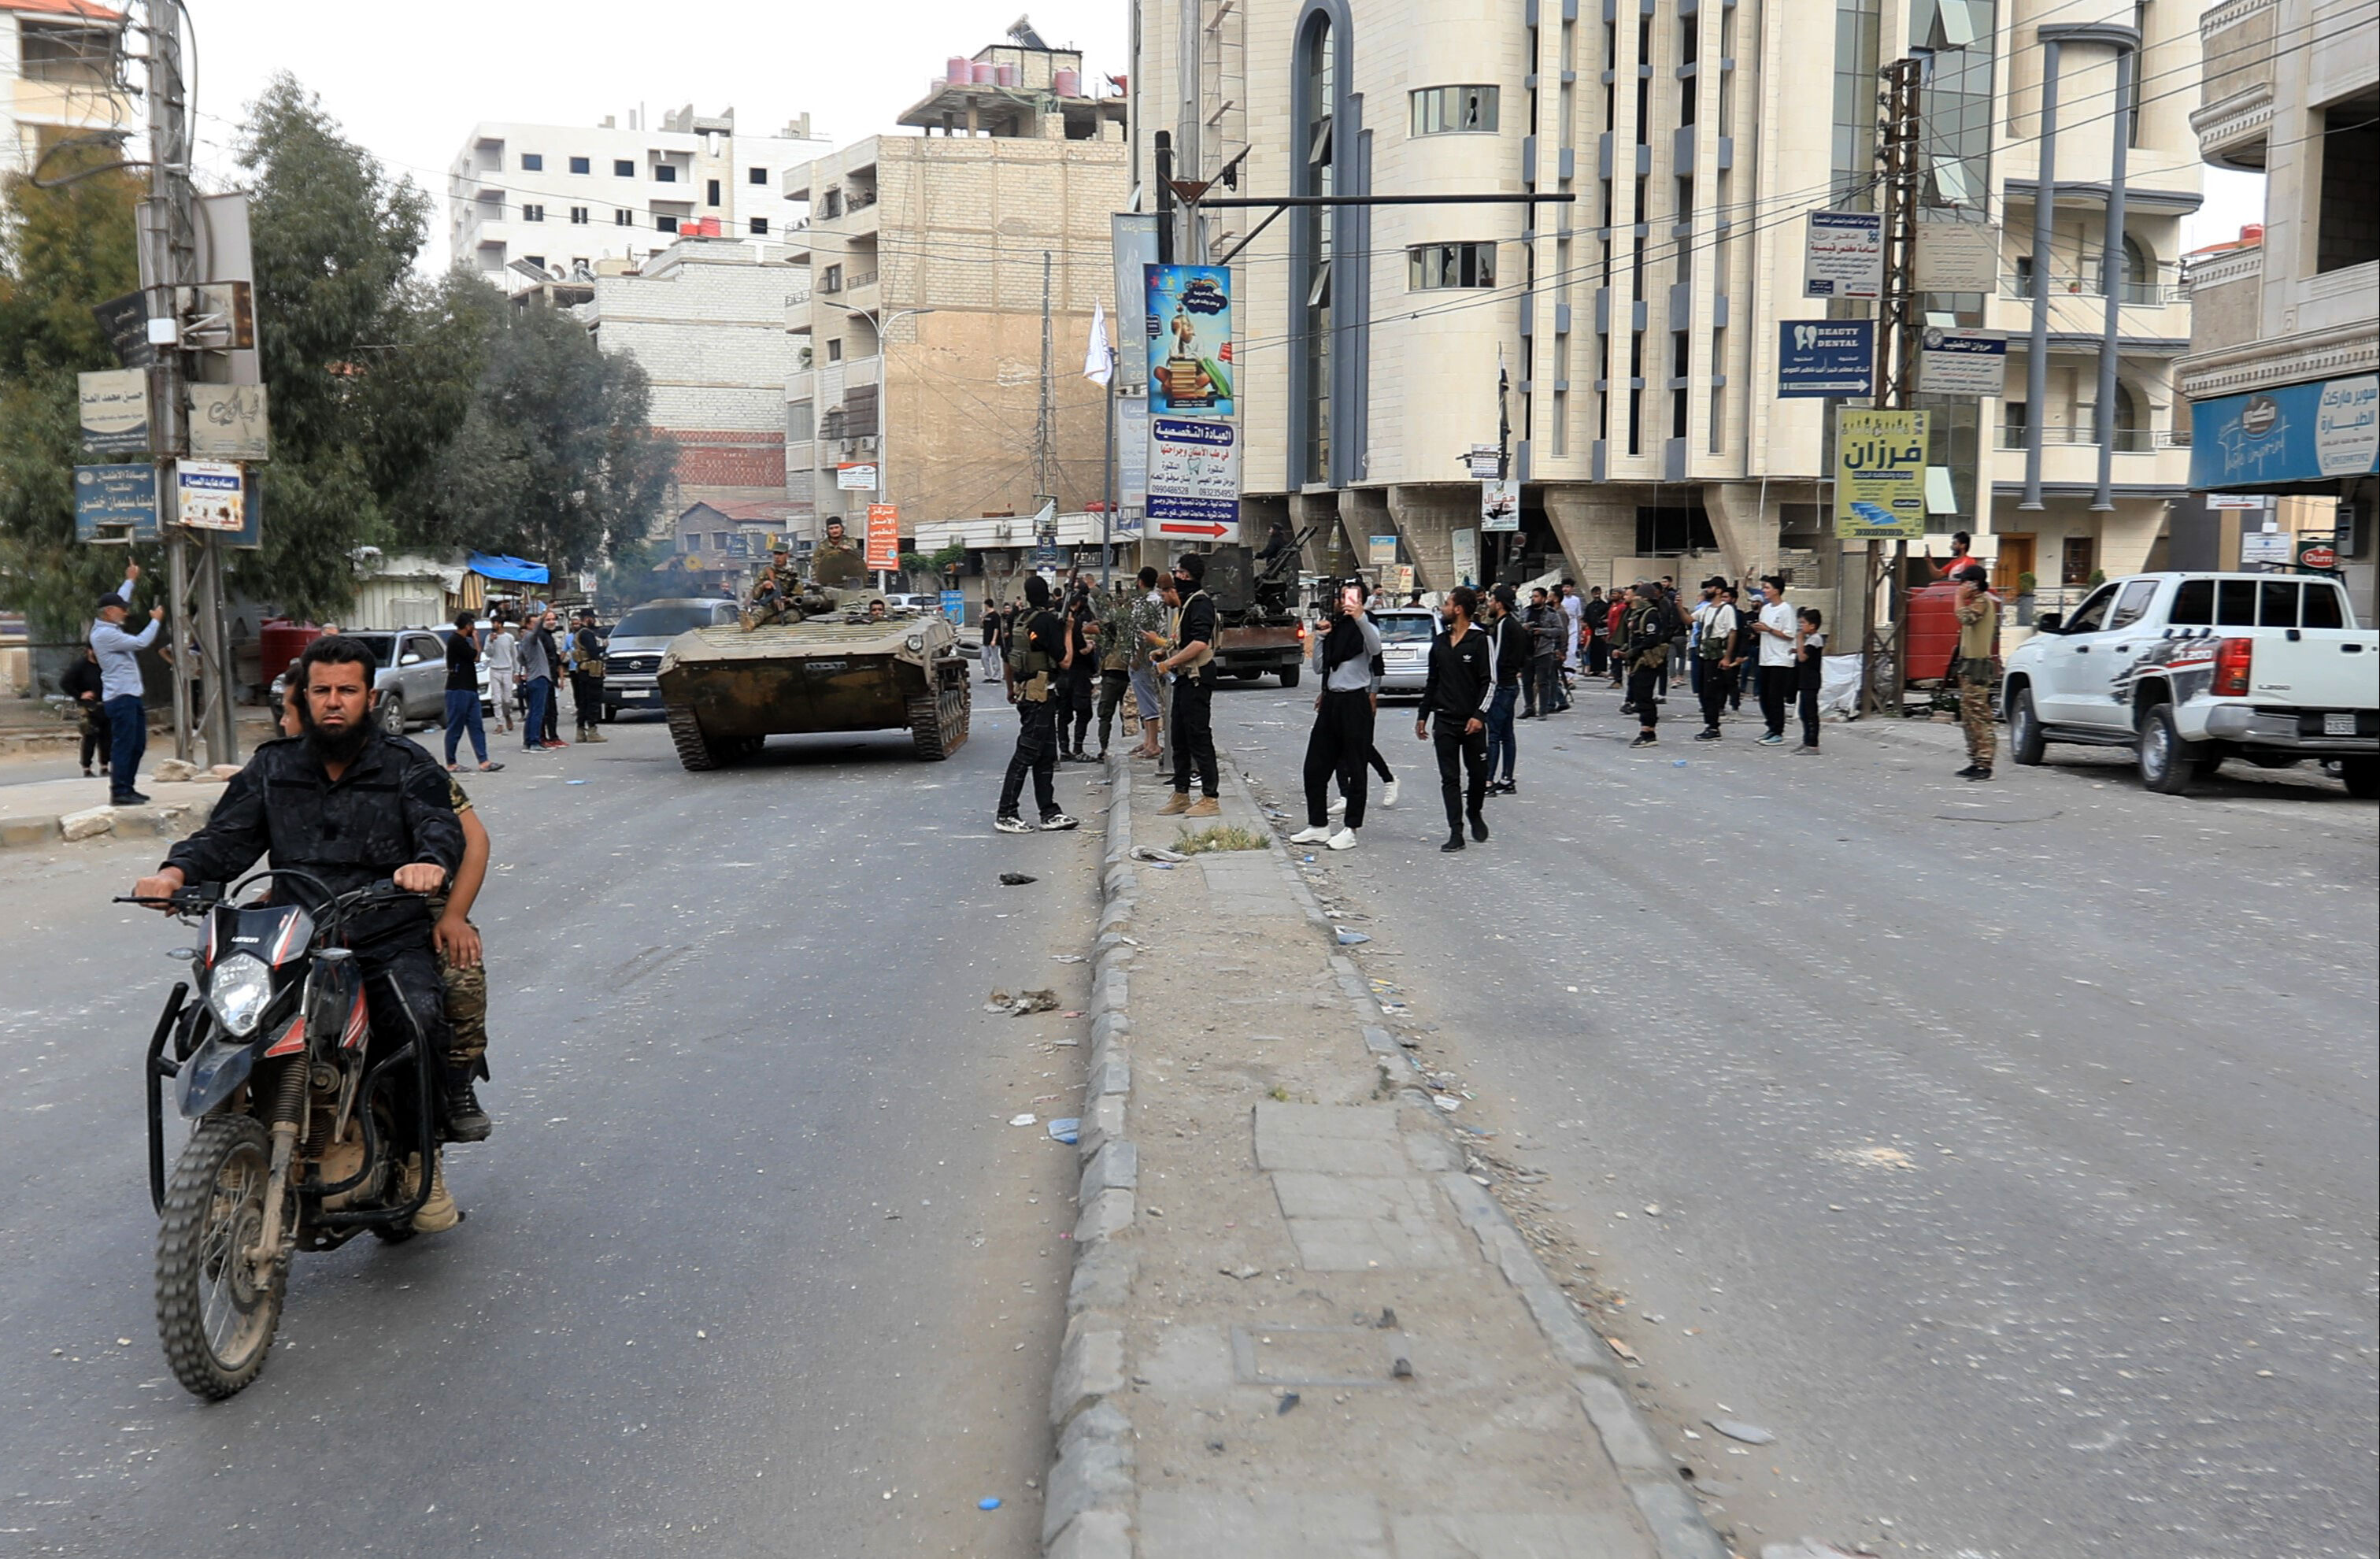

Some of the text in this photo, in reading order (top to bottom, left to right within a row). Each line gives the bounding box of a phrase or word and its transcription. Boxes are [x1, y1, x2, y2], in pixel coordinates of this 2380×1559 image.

[2323, 388, 2378, 409] سوبر ماركت
[1156, 421, 1232, 443] العيادة التخصصية
[2320, 409, 2375, 435] الطيارة
[1844, 439, 1922, 469] فرزان
